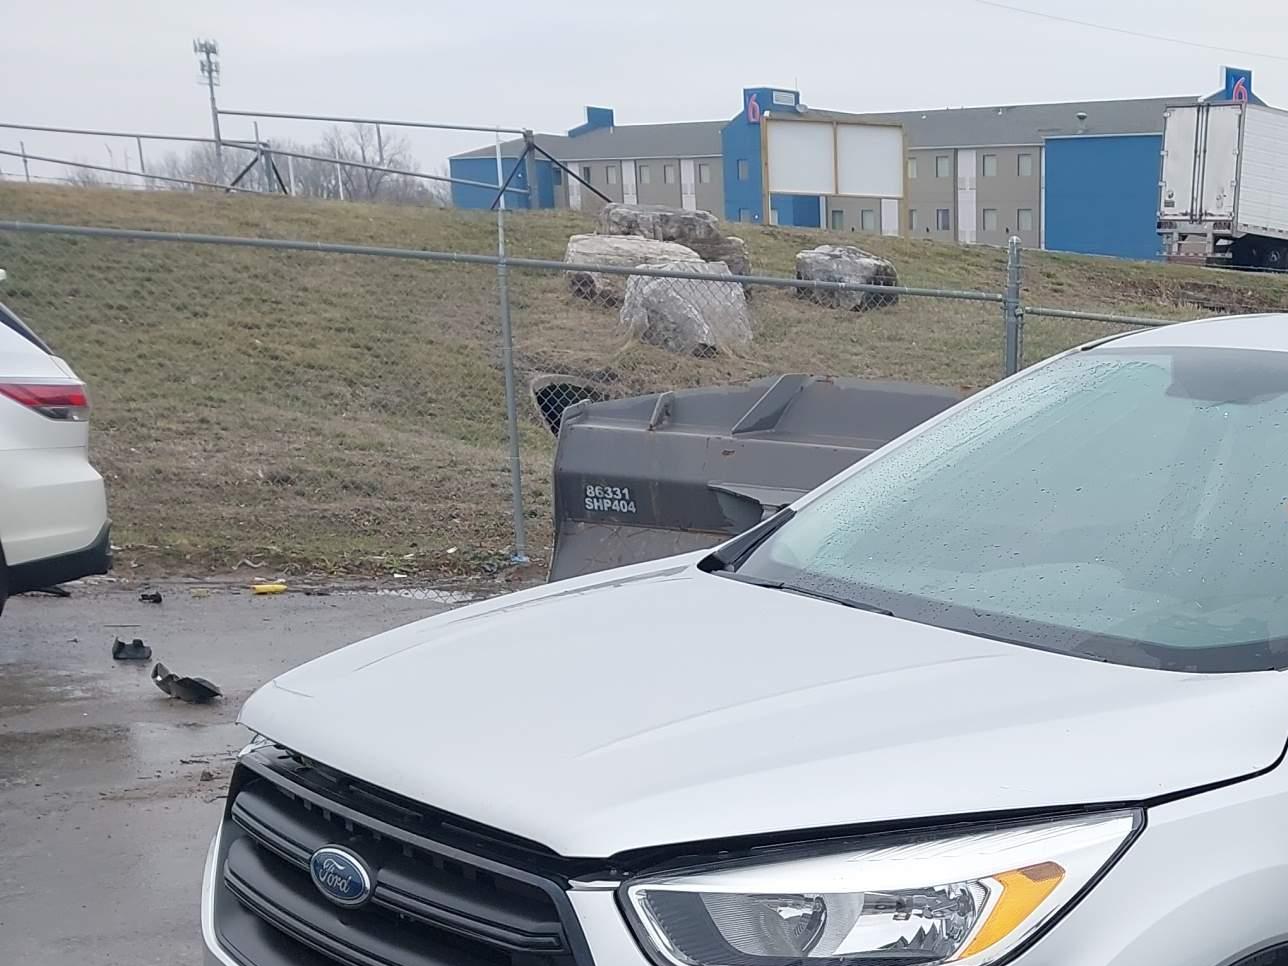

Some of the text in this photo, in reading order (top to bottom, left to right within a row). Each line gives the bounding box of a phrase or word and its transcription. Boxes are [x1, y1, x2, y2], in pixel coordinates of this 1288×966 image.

[585, 485, 630, 500] 86331
[584, 497, 637, 513] SHP404
[319, 858, 352, 893] Ford
